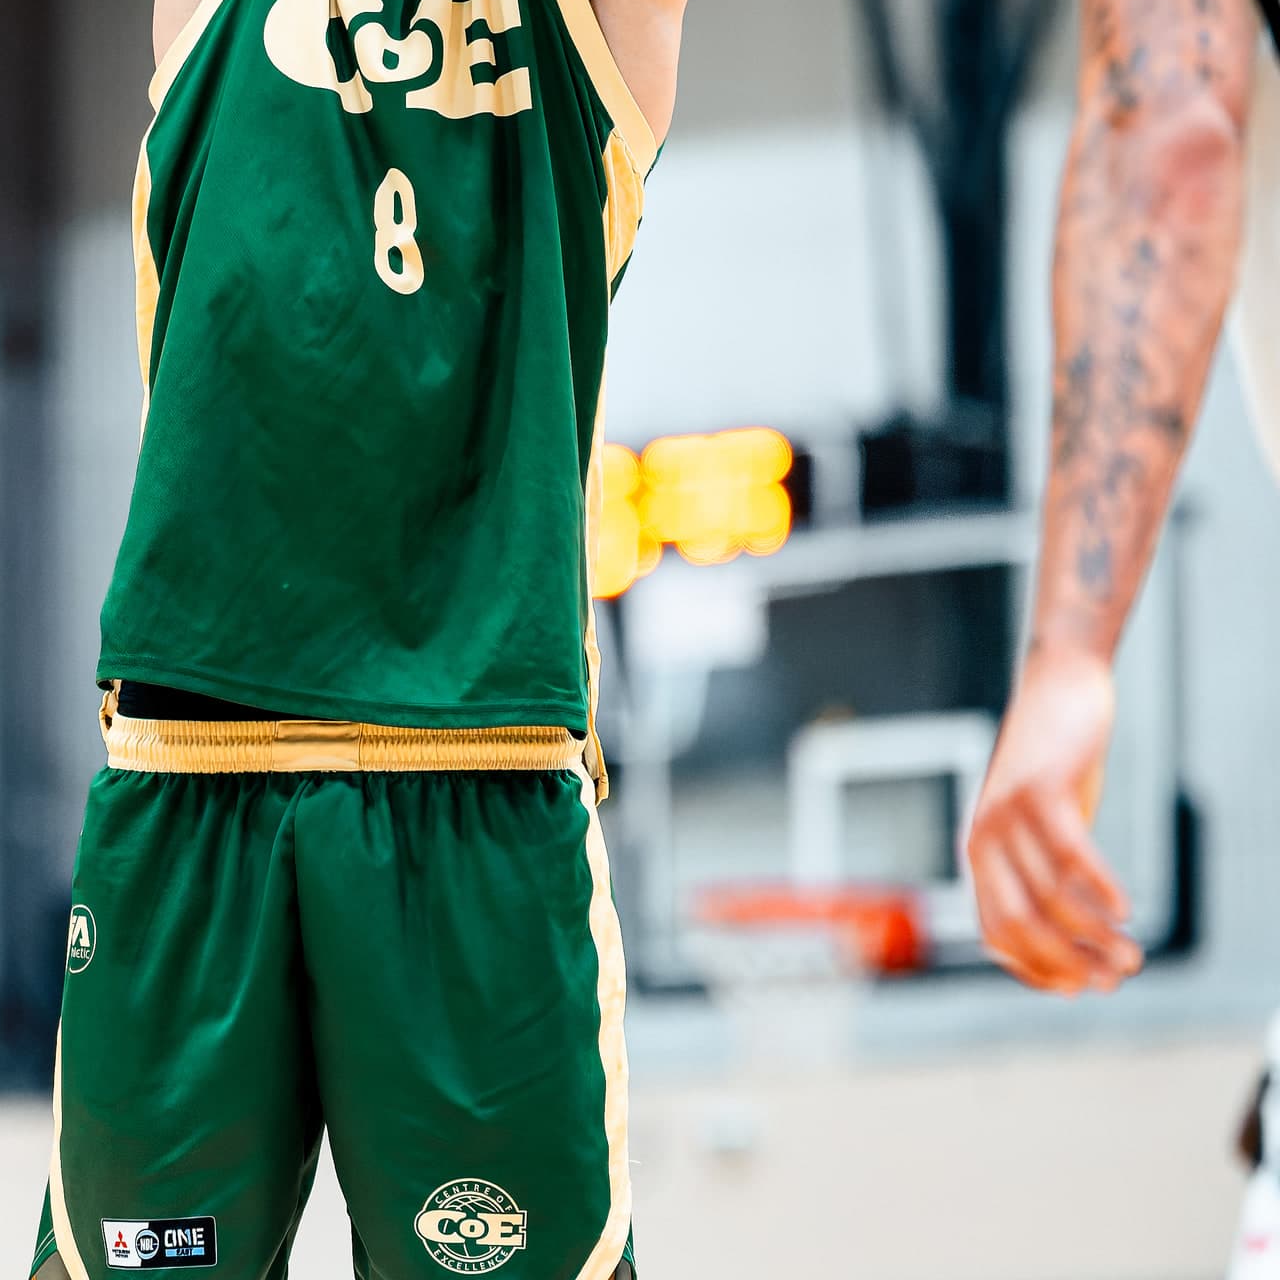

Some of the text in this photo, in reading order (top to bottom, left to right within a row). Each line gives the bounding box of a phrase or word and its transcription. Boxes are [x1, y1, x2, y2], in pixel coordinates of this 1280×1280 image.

[373, 168, 425, 295] 8
[435, 1183, 513, 1212] CENTRE OF
[140, 1238, 154, 1252] NBL
[164, 1227, 205, 1248] ONE
[433, 1249, 509, 1272] EXCELLENCE
